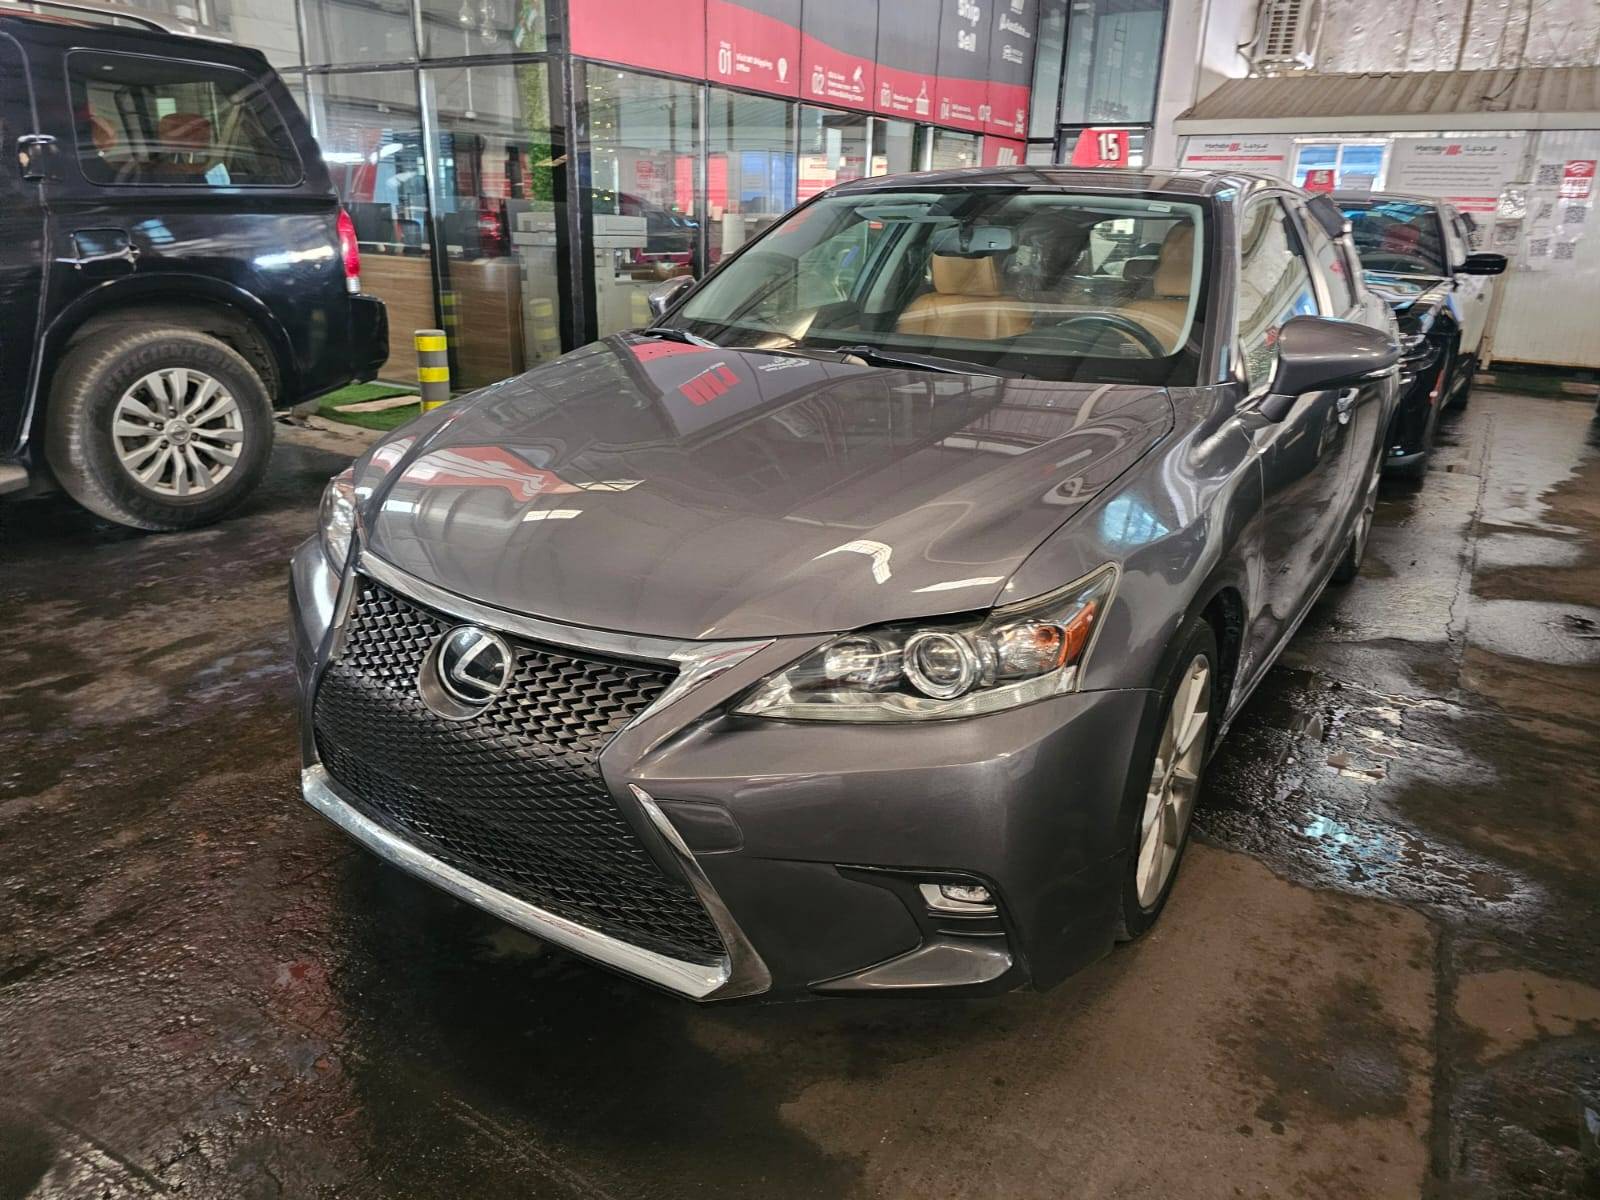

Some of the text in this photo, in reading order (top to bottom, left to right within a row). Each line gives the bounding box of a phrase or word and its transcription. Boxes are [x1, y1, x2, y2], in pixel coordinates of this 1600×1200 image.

[719, 49, 731, 75] 01
[812, 72, 824, 95] 02
[1097, 133, 1120, 161] 15
